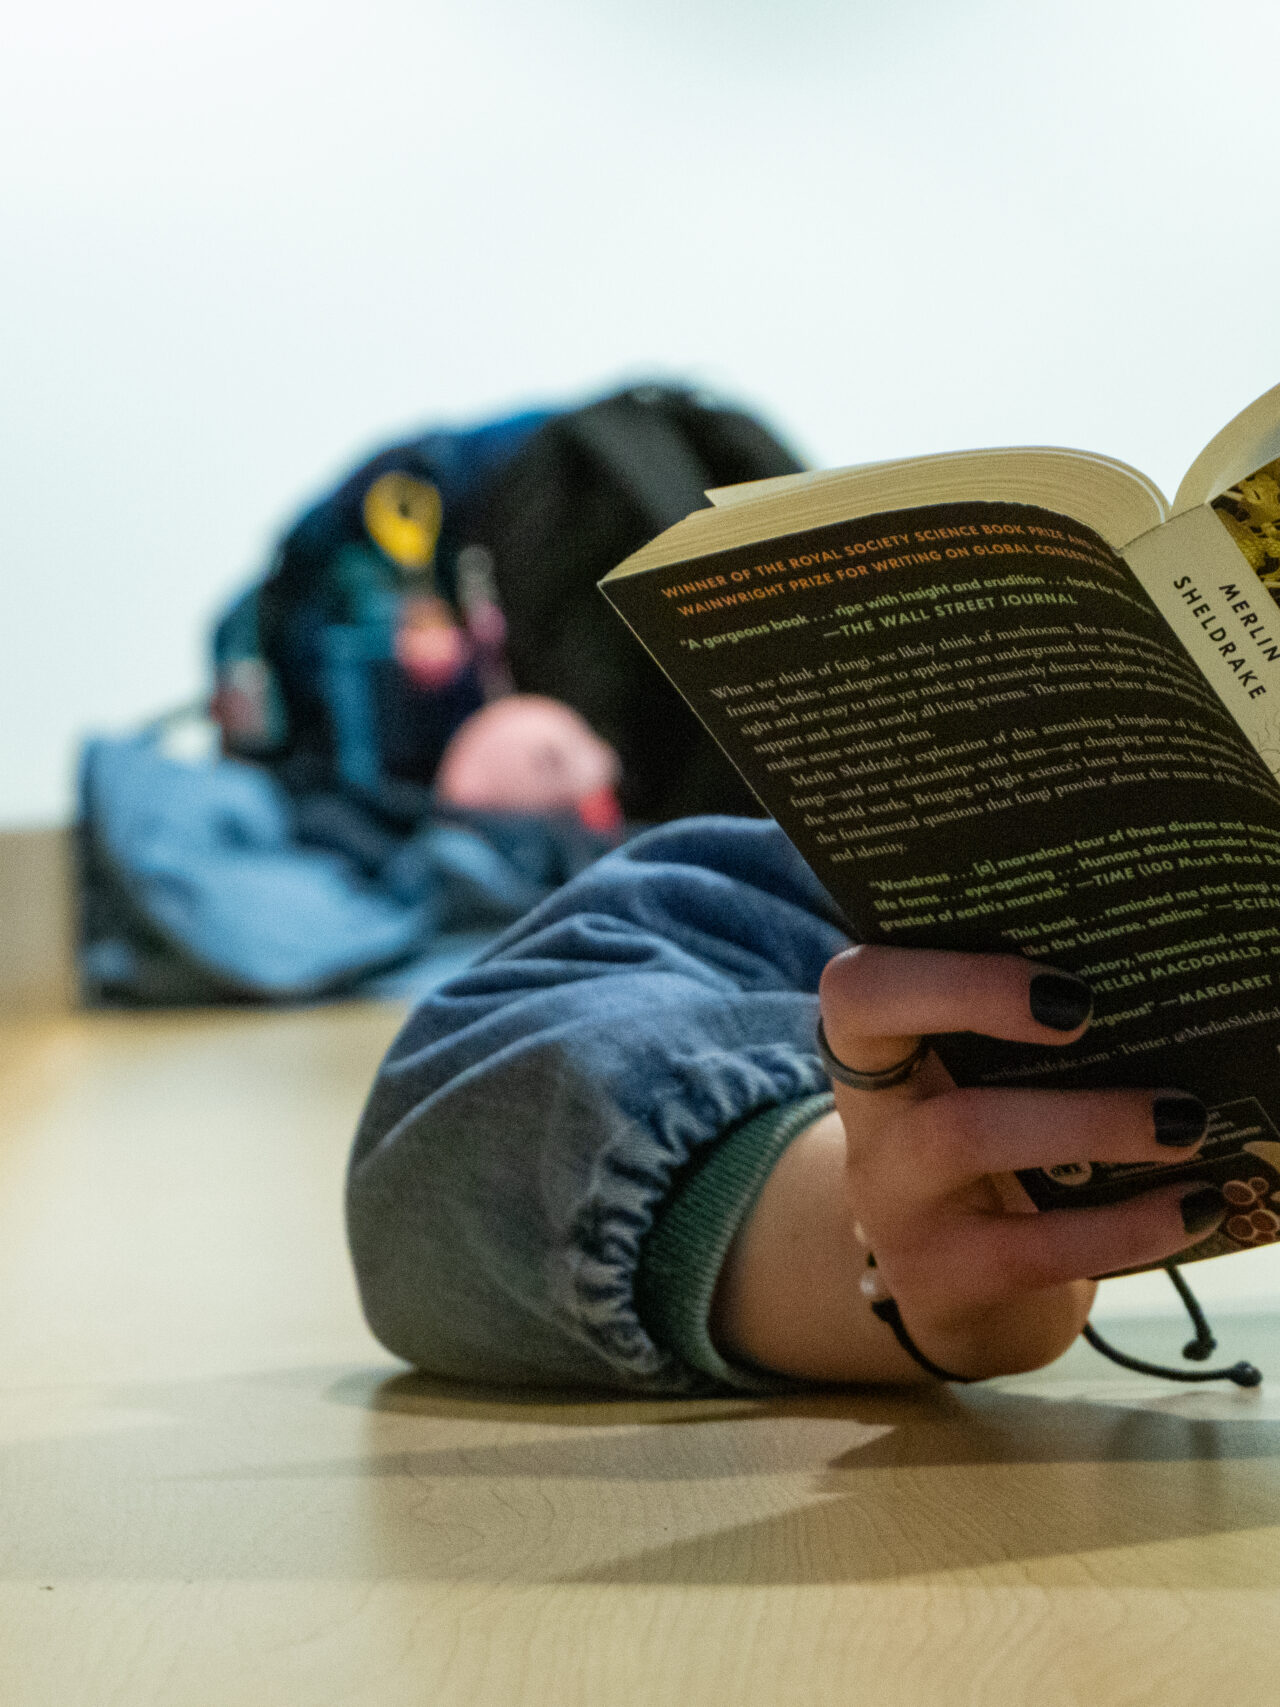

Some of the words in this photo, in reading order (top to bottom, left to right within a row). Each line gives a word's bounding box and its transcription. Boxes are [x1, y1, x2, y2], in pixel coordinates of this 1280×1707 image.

[662, 574, 728, 599] WINNER
[731, 570, 752, 582] OF
[755, 561, 787, 577] THE
[788, 549, 843, 569] ROYAL
[845, 534, 909, 556] SOCIETY
[914, 525, 979, 543] SCIENCE
[981, 524, 1025, 536] BOOK
[1028, 526, 1064, 541] PRIZE
[677, 583, 786, 617] WAINWRIGHT
[788, 572, 834, 592] PRIZE
[836, 565, 869, 581] FOR
[871, 550, 942, 573] WRITING
[945, 546, 970, 559] ON
[973, 543, 1033, 556] GLOBAL
[703, 623, 770, 648] gorgeous
[769, 614, 810, 631] book
[834, 603, 864, 617] ripe
[866, 593, 899, 609] with
[899, 583, 951, 603] insight
[953, 578, 982, 593] and
[983, 574, 1046, 587] erudition
[1066, 576, 1095, 590] food
[879, 609, 931, 629] WALL
[935, 597, 995, 617] STREET
[1001, 593, 1078, 606] JOURNAL
[1174, 576, 1266, 699] SHELDRAKE
[711, 684, 753, 699] When
[756, 678, 776, 689] we
[779, 667, 815, 686] think
[834, 655, 876, 673] fungi,
[877, 652, 898, 663] we
[899, 642, 936, 660] likely
[940, 634, 976, 651] think
[996, 625, 1073, 641] mushrooms.
[1074, 622, 1098, 635] But
[726, 700, 779, 718] fruiting
[776, 687, 826, 706] bodies,
[828, 673, 892, 695] analogous
[911, 660, 952, 679] apples
[994, 642, 1076, 661] underground
[741, 719, 773, 737] sight
[775, 713, 800, 728] and
[823, 704, 849, 719] easy
[867, 692, 896, 708] miss
[920, 680, 955, 695] make
[987, 665, 1047, 686] massively
[1049, 660, 1091, 674] diverse
[1090, 659, 1145, 674] kingdom
[753, 735, 803, 754] support
[806, 727, 831, 743] and
[832, 718, 877, 737] sustain
[879, 709, 918, 729] nearly
[937, 696, 978, 713] living
[977, 689, 1031, 705] systems.
[1059, 681, 1092, 693] more
[766, 754, 807, 773] makes
[808, 748, 842, 763] sense
[843, 738, 895, 755] without
[896, 728, 937, 746] them.
[790, 769, 837, 787] Merlin
[838, 754, 911, 777] Sheldrake's
[914, 739, 988, 764] exploration
[1042, 716, 1115, 736] astonishing
[1114, 714, 1171, 729] kingdom
[894, 763, 975, 788] relationships
[977, 751, 1009, 769] with
[1084, 733, 1144, 747] changing
[828, 804, 867, 822] world
[869, 799, 911, 814] works.
[913, 785, 974, 804] Bringing
[991, 774, 1024, 789] light
[838, 815, 920, 840] fundamental
[923, 805, 984, 827] questions
[1015, 788, 1052, 804] fungi
[1055, 777, 1106, 797] provoke
[899, 893, 941, 909] forms
[964, 869, 1056, 898] eye-opening
[1078, 847, 1141, 870] Humans
[1143, 838, 1190, 856] should
[1192, 837, 1248, 850] consider
[997, 844, 1074, 870] marvelous
[1074, 836, 1105, 851] tour
[1126, 824, 1166, 839] these
[1168, 820, 1217, 833] diverse
[879, 913, 936, 933] greatest
[956, 901, 1004, 921] earth's
[1178, 853, 1262, 869] Must-Read
[1104, 892, 1173, 918] reminded
[1200, 881, 1232, 896] that
[1233, 881, 1269, 895] fungi
[1077, 920, 1146, 944] Universe,
[1136, 933, 1233, 962] impassioned,
[1091, 971, 1146, 994] HELEN
[1151, 946, 1267, 979] MACDONALD,
